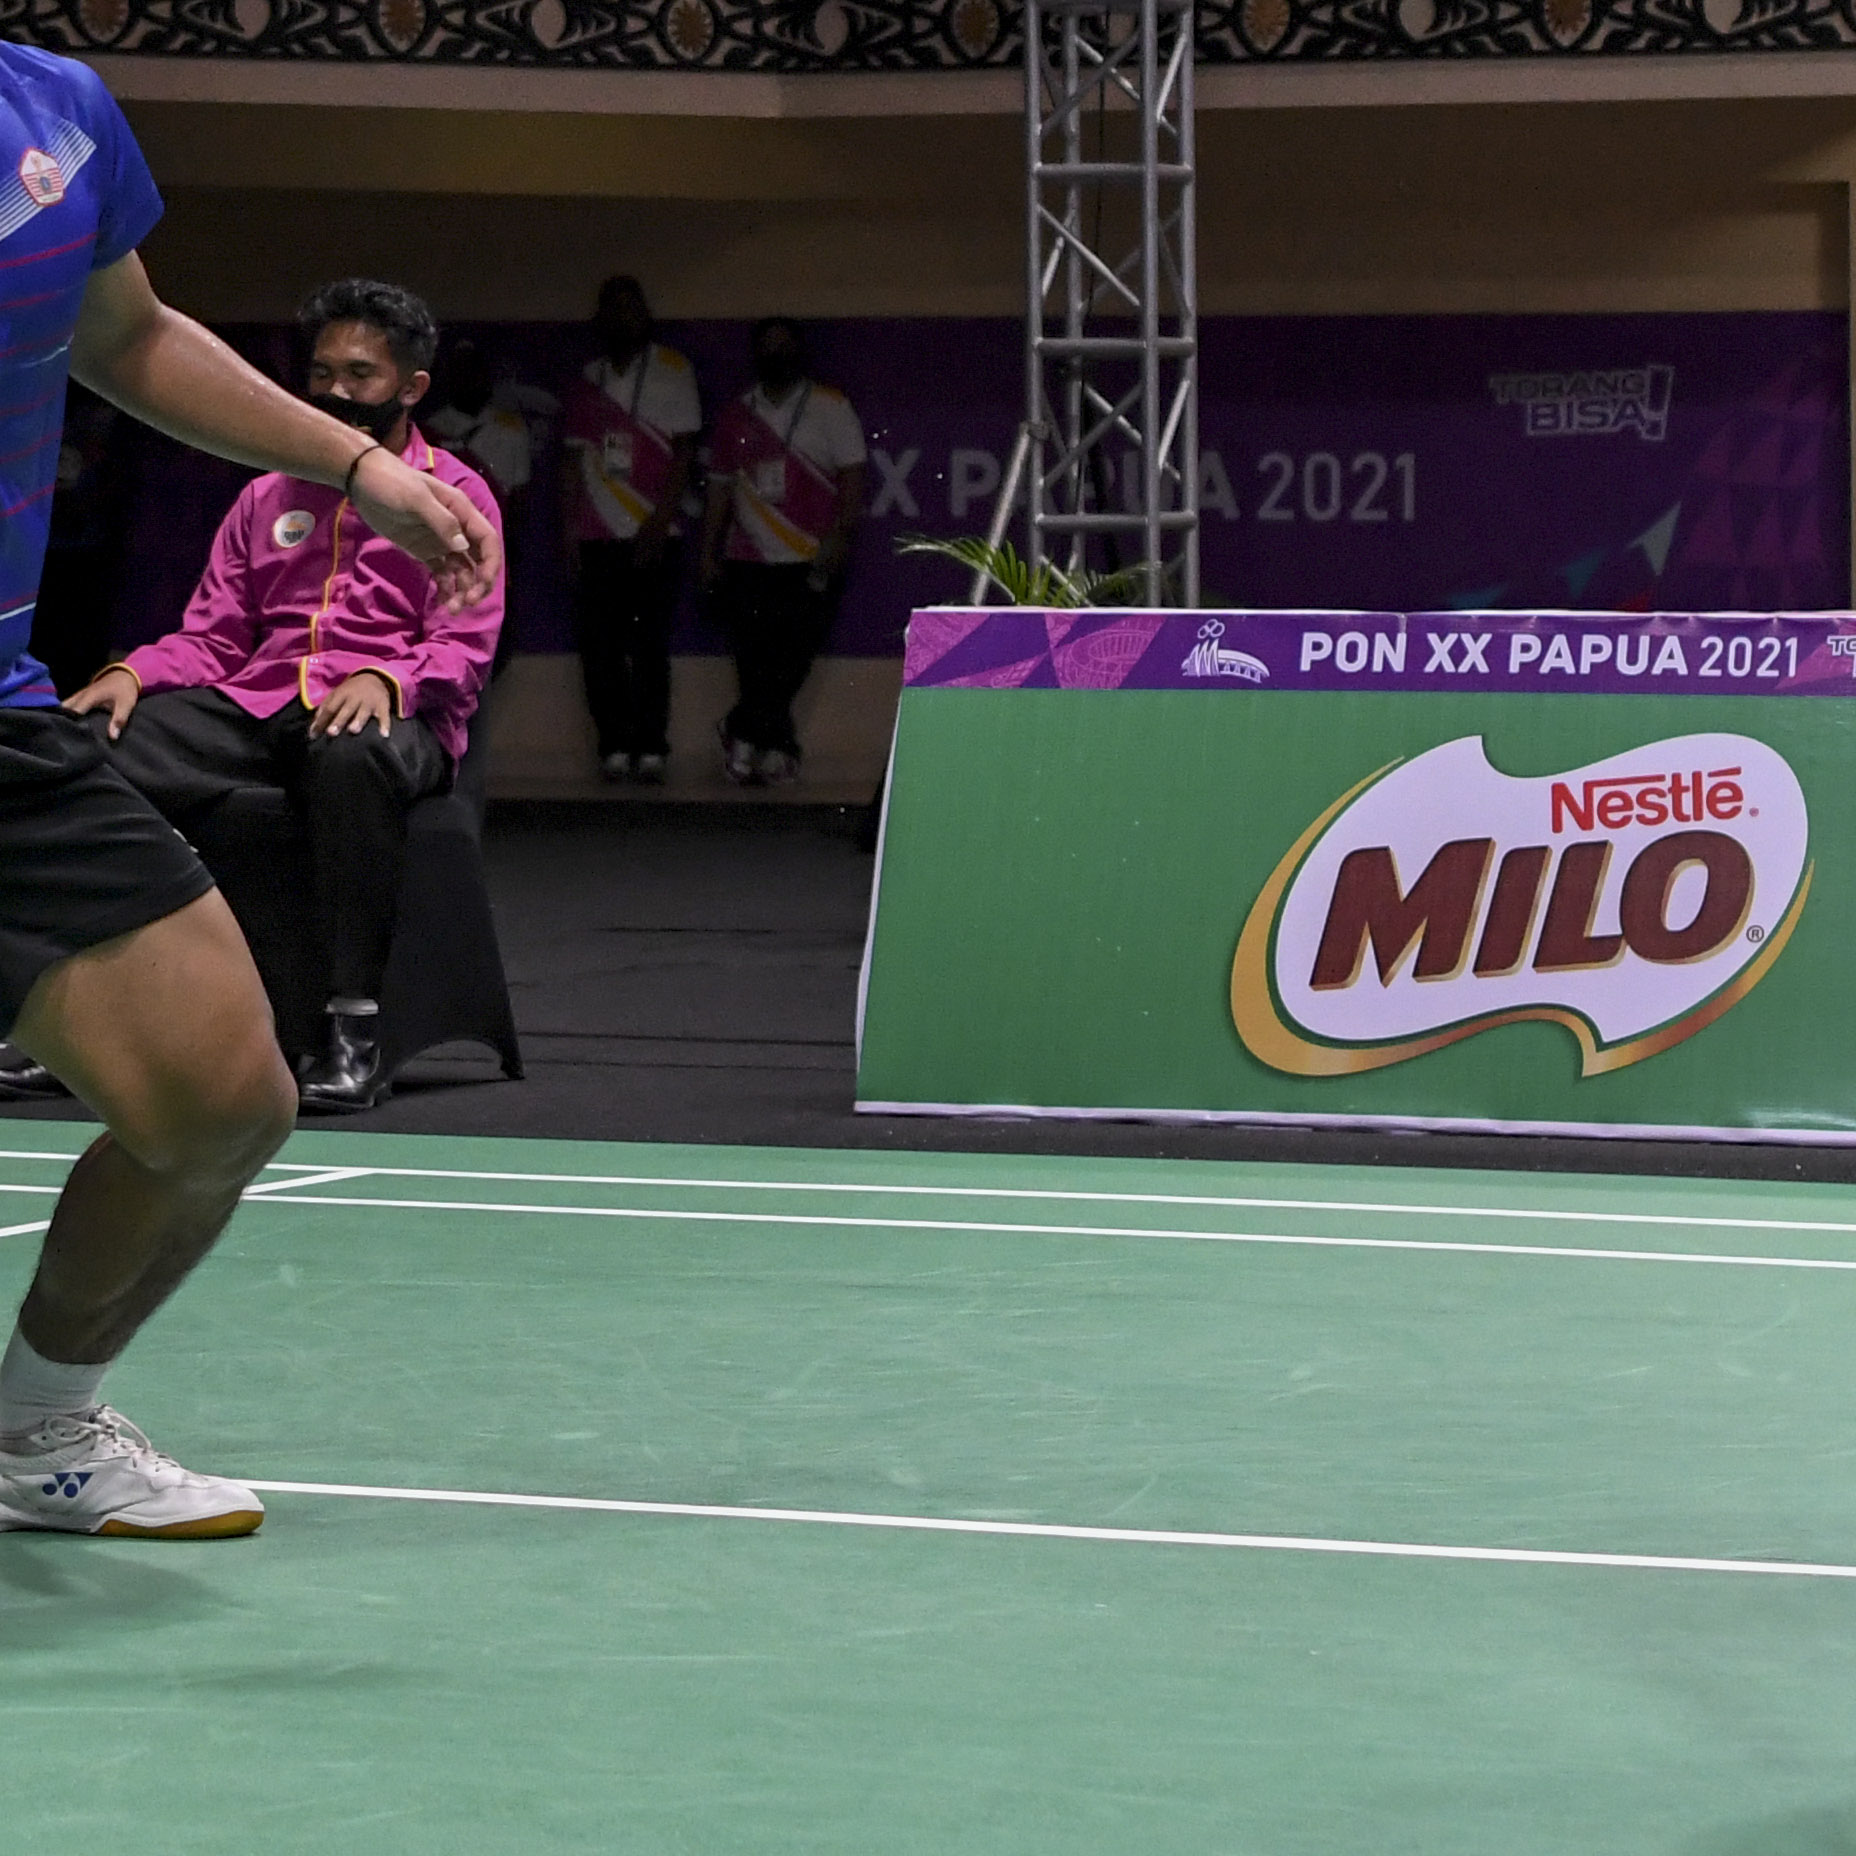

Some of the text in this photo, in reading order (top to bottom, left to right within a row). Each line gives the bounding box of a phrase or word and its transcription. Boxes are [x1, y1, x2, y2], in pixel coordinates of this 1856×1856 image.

[1256, 451, 1417, 522] 2021
[1299, 631, 1407, 673] PON
[1423, 632, 1493, 674] XX
[1507, 633, 1689, 677] PAPUA
[1697, 636, 1798, 679] 2021
[1308, 829, 1756, 992] MILO
